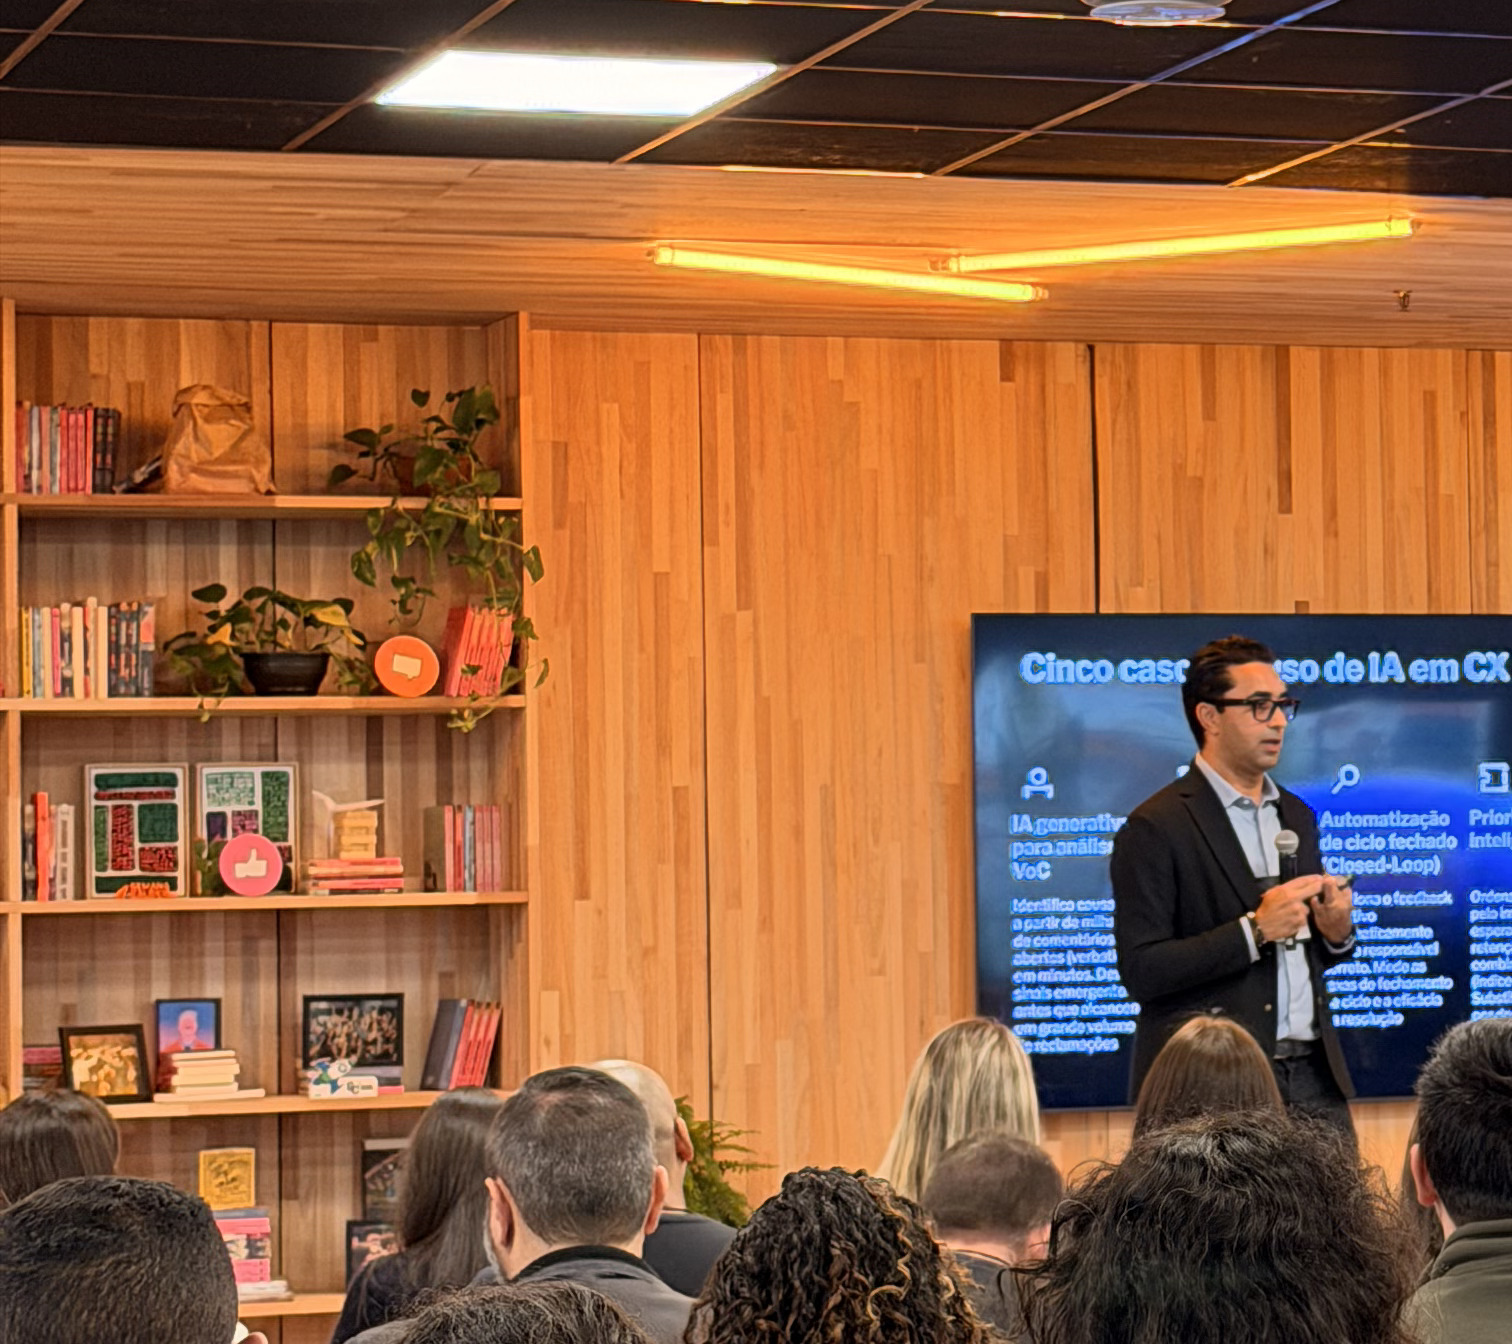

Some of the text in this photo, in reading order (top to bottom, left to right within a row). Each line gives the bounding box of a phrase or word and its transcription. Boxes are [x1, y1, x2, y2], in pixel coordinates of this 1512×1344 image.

[1019, 651, 1115, 685] Cinco
[1118, 658, 1190, 684] caso
[1323, 651, 1365, 684] de
[1367, 651, 1406, 684] IA
[1408, 658, 1460, 684] em
[1463, 651, 1511, 684] CX
[1033, 812, 1128, 836] generativ
[1319, 809, 1451, 831] Automatização
[1011, 840, 1053, 860] para
[1319, 831, 1459, 851] de ciclo fechado
[1011, 859, 1051, 881] VoC
[1075, 899, 1116, 912] causa
[1052, 984, 1129, 1001] emergente
